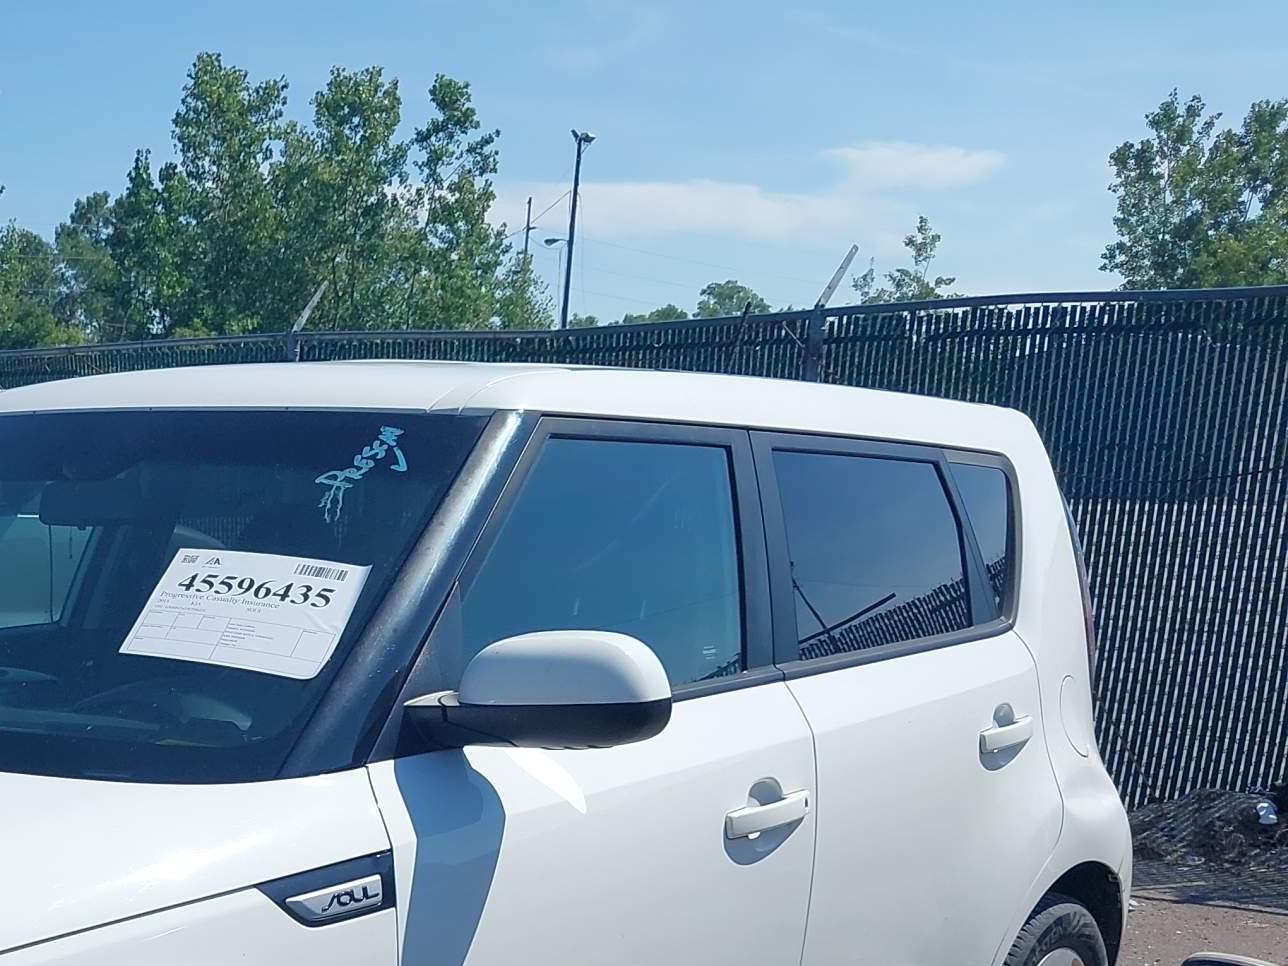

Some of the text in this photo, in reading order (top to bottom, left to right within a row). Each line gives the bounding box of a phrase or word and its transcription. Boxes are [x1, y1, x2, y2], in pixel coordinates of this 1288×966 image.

[160, 591, 281, 609] Progressive Casualty Insurance
[177, 573, 336, 608] 45596435
[321, 886, 379, 913] SOUL
